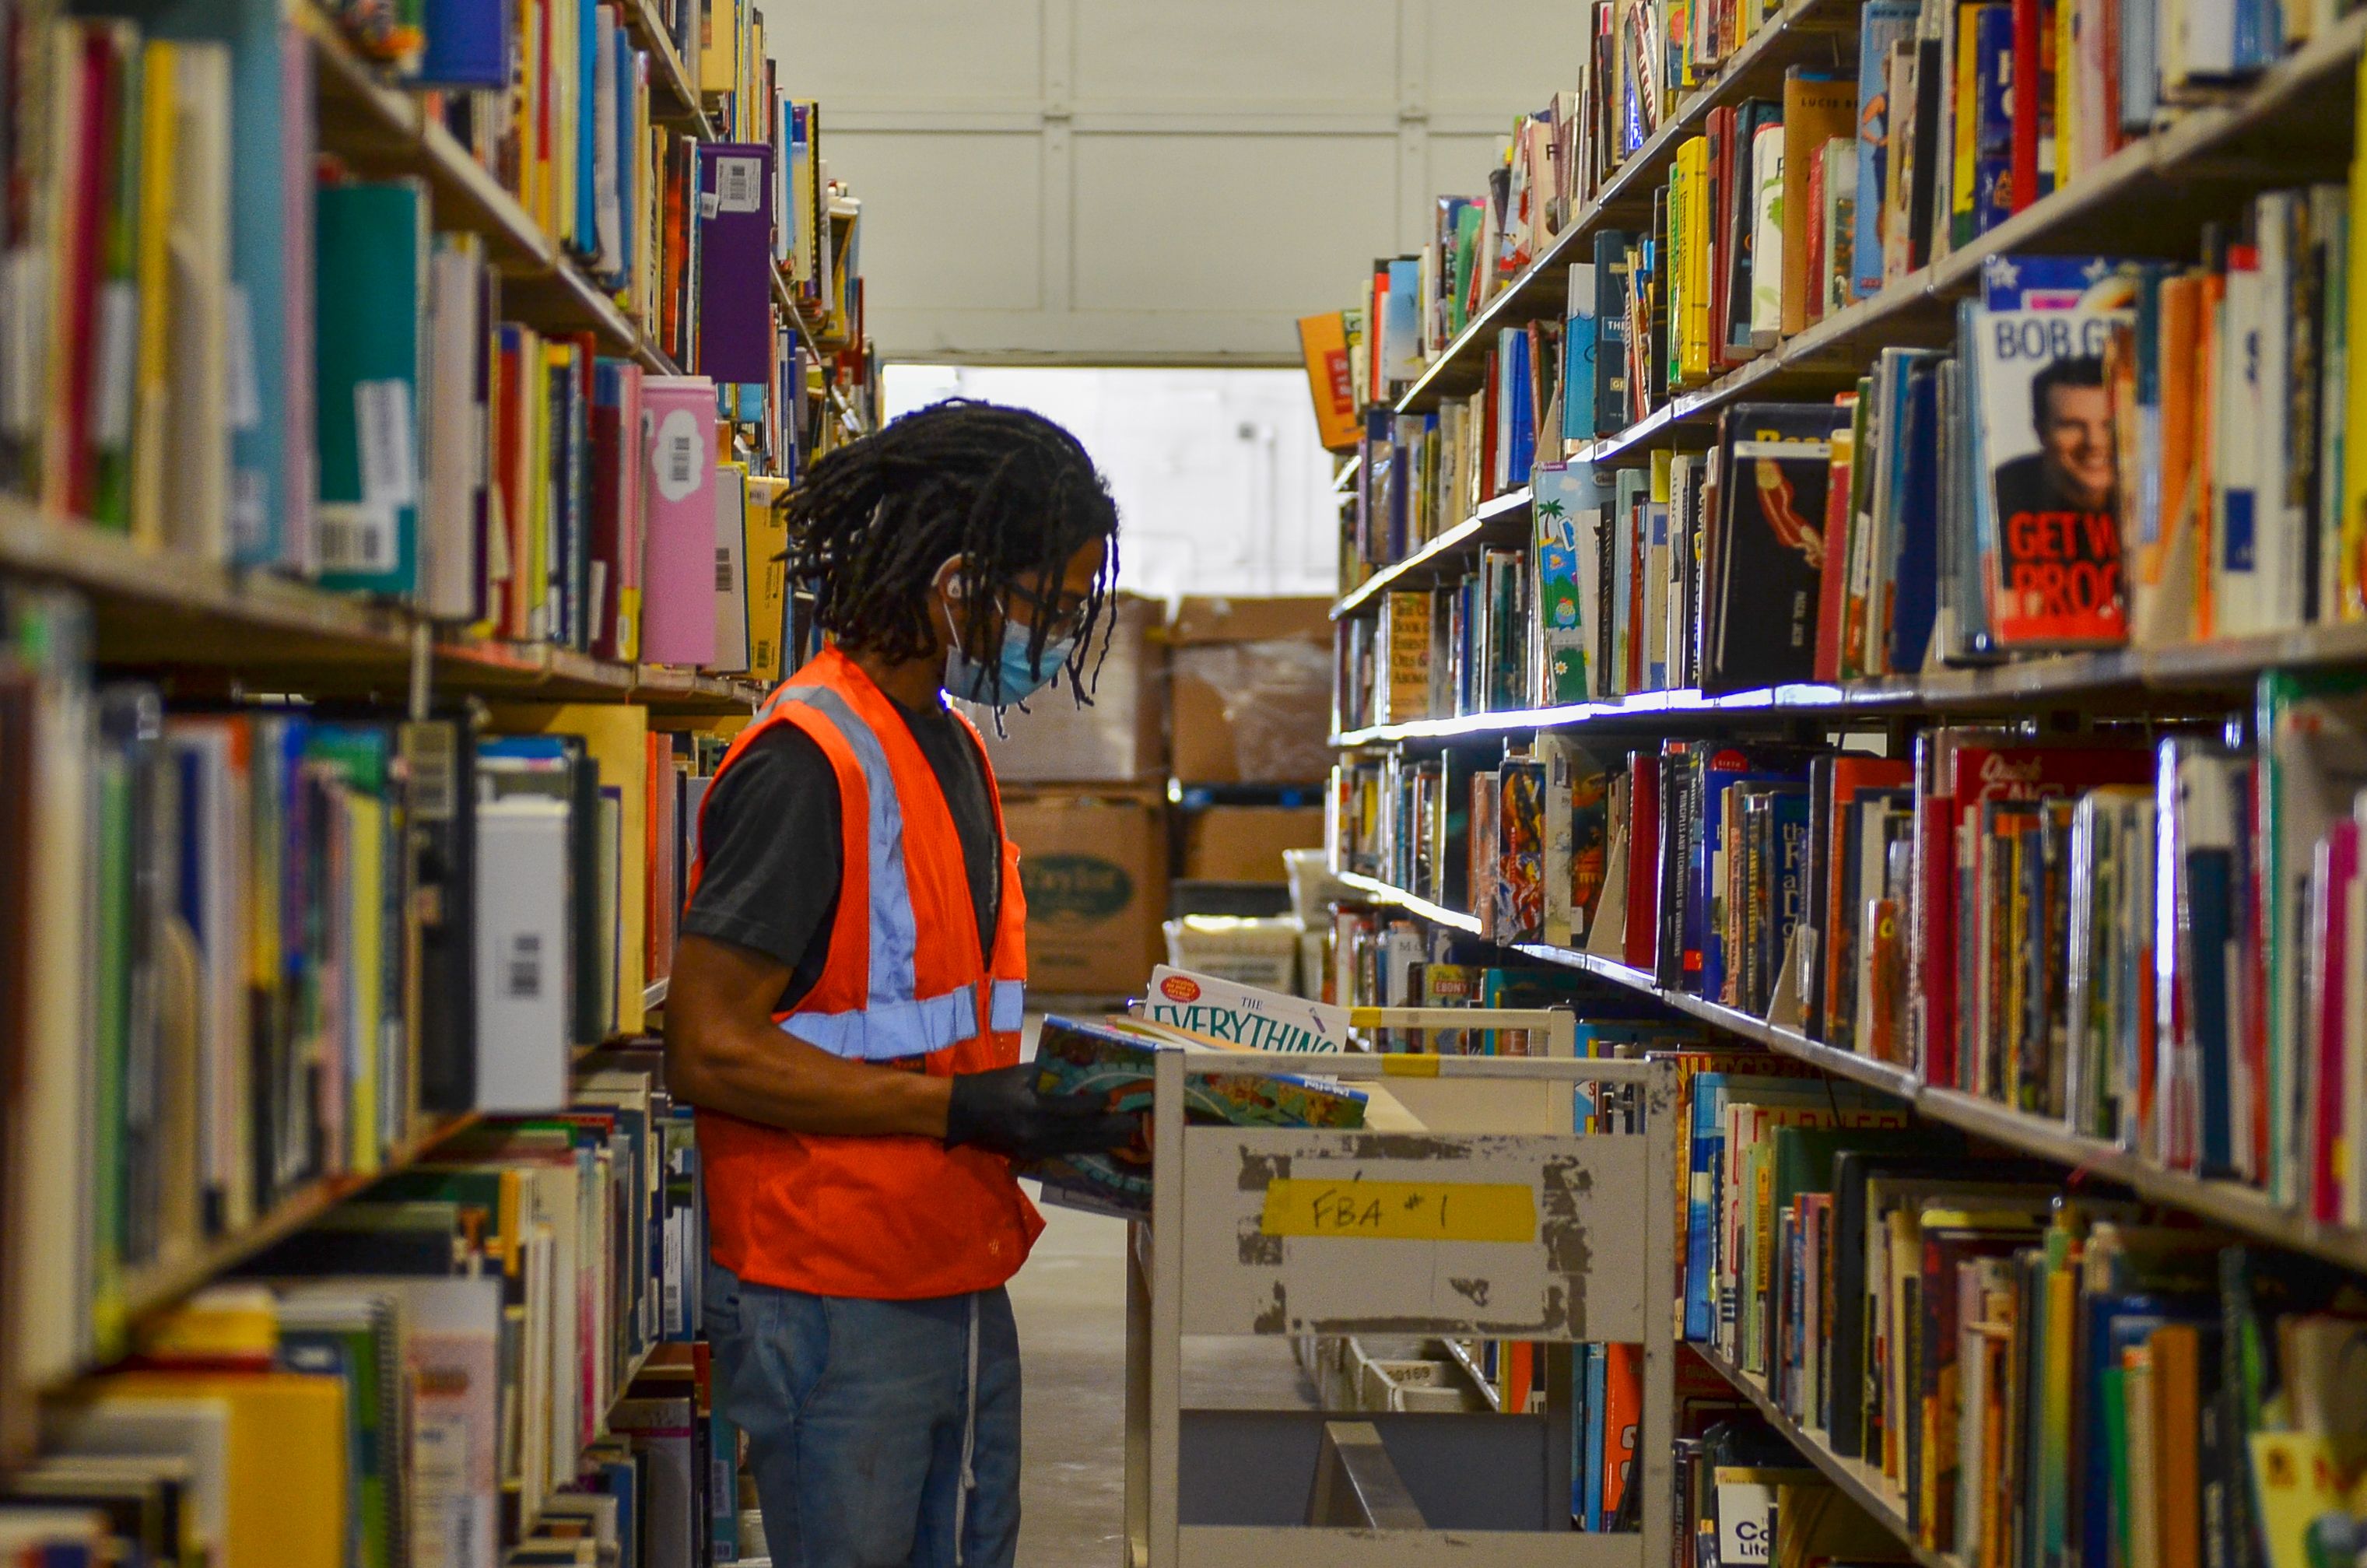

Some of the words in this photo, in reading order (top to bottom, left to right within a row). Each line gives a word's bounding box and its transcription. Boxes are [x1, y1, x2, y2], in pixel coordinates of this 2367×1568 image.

[1996, 317, 2071, 360] BOB
[2008, 510, 2078, 560] GET
[1678, 789, 1688, 833] PRINCIPLES
[1675, 852, 1685, 898] TECHNIQUES
[1673, 910, 1682, 957] VIBRATIONS
[1240, 995, 1264, 1011] THE
[1436, 981, 1468, 994] EBONY
[1312, 1188, 1382, 1229] FBA
